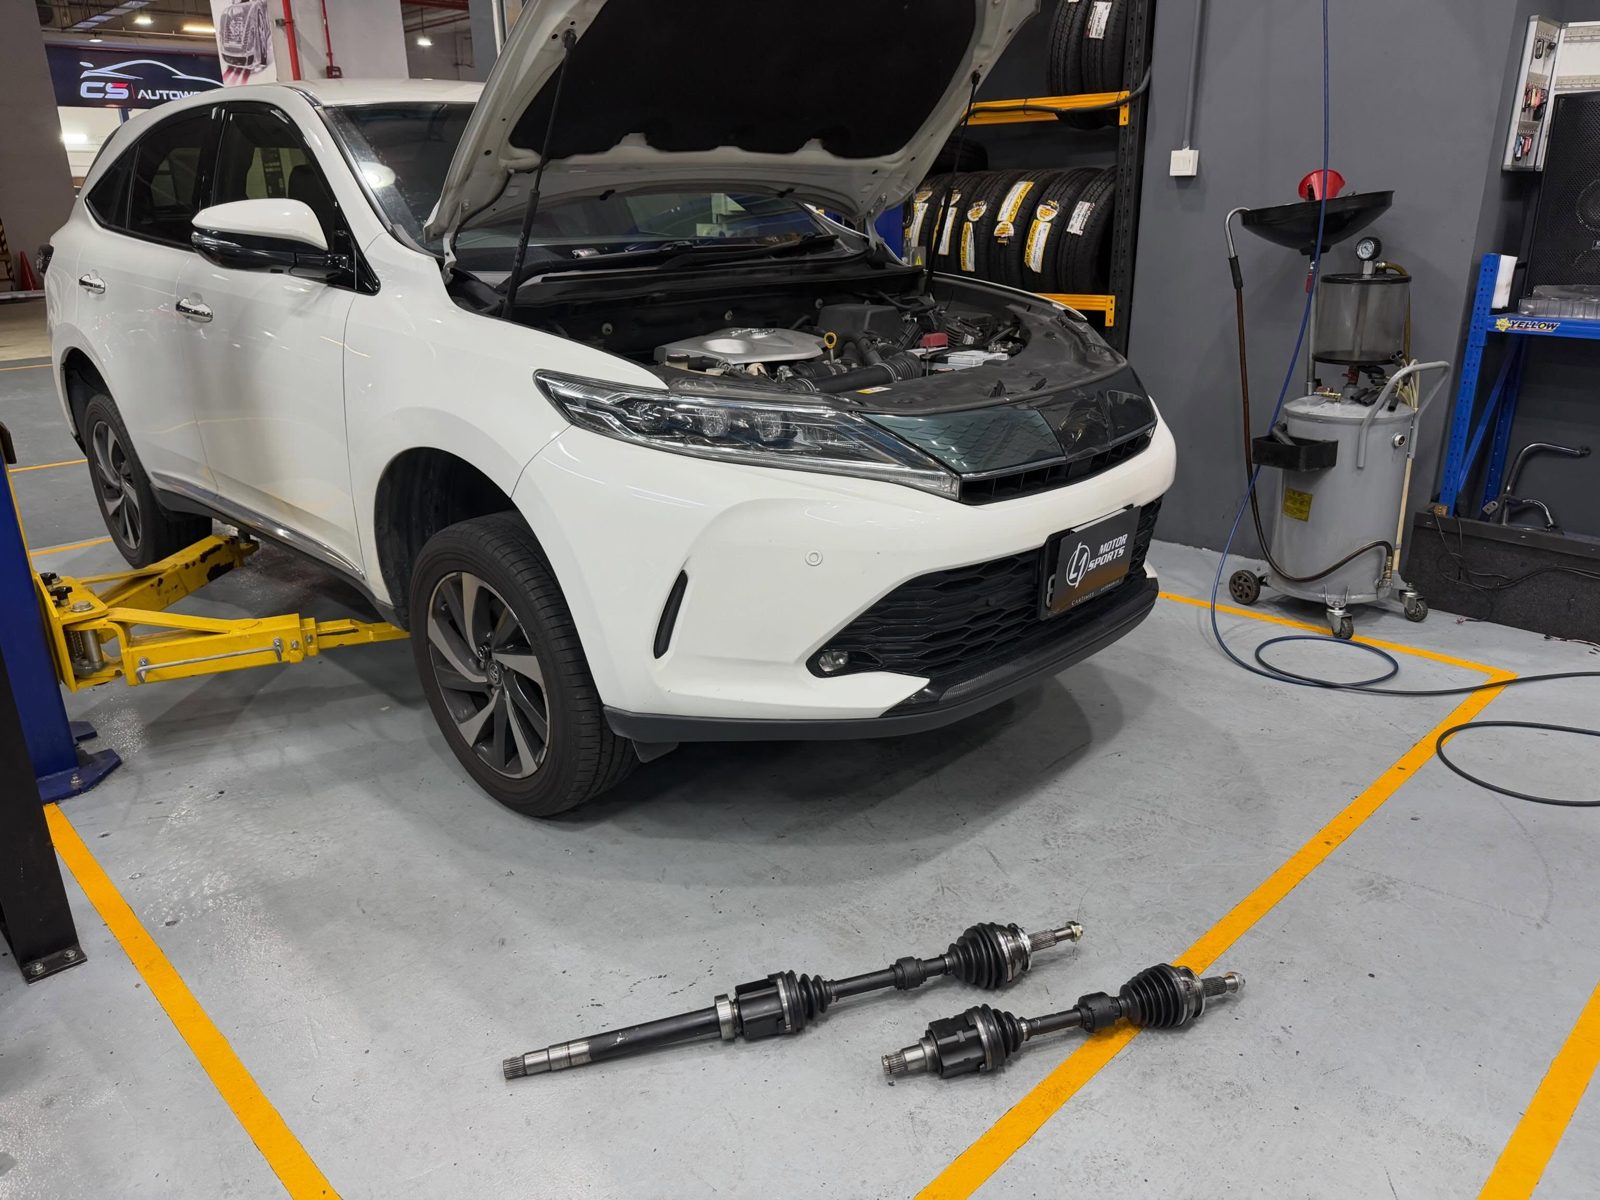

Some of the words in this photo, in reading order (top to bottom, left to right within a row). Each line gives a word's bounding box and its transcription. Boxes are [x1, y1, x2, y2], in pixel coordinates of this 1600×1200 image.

[80, 81, 129, 100] CS
[138, 90, 201, 99] AUTOW
[1510, 320, 1558, 330] YELLOW
[1098, 534, 1128, 554] MOTOR
[1087, 546, 1125, 571] SPORTS
